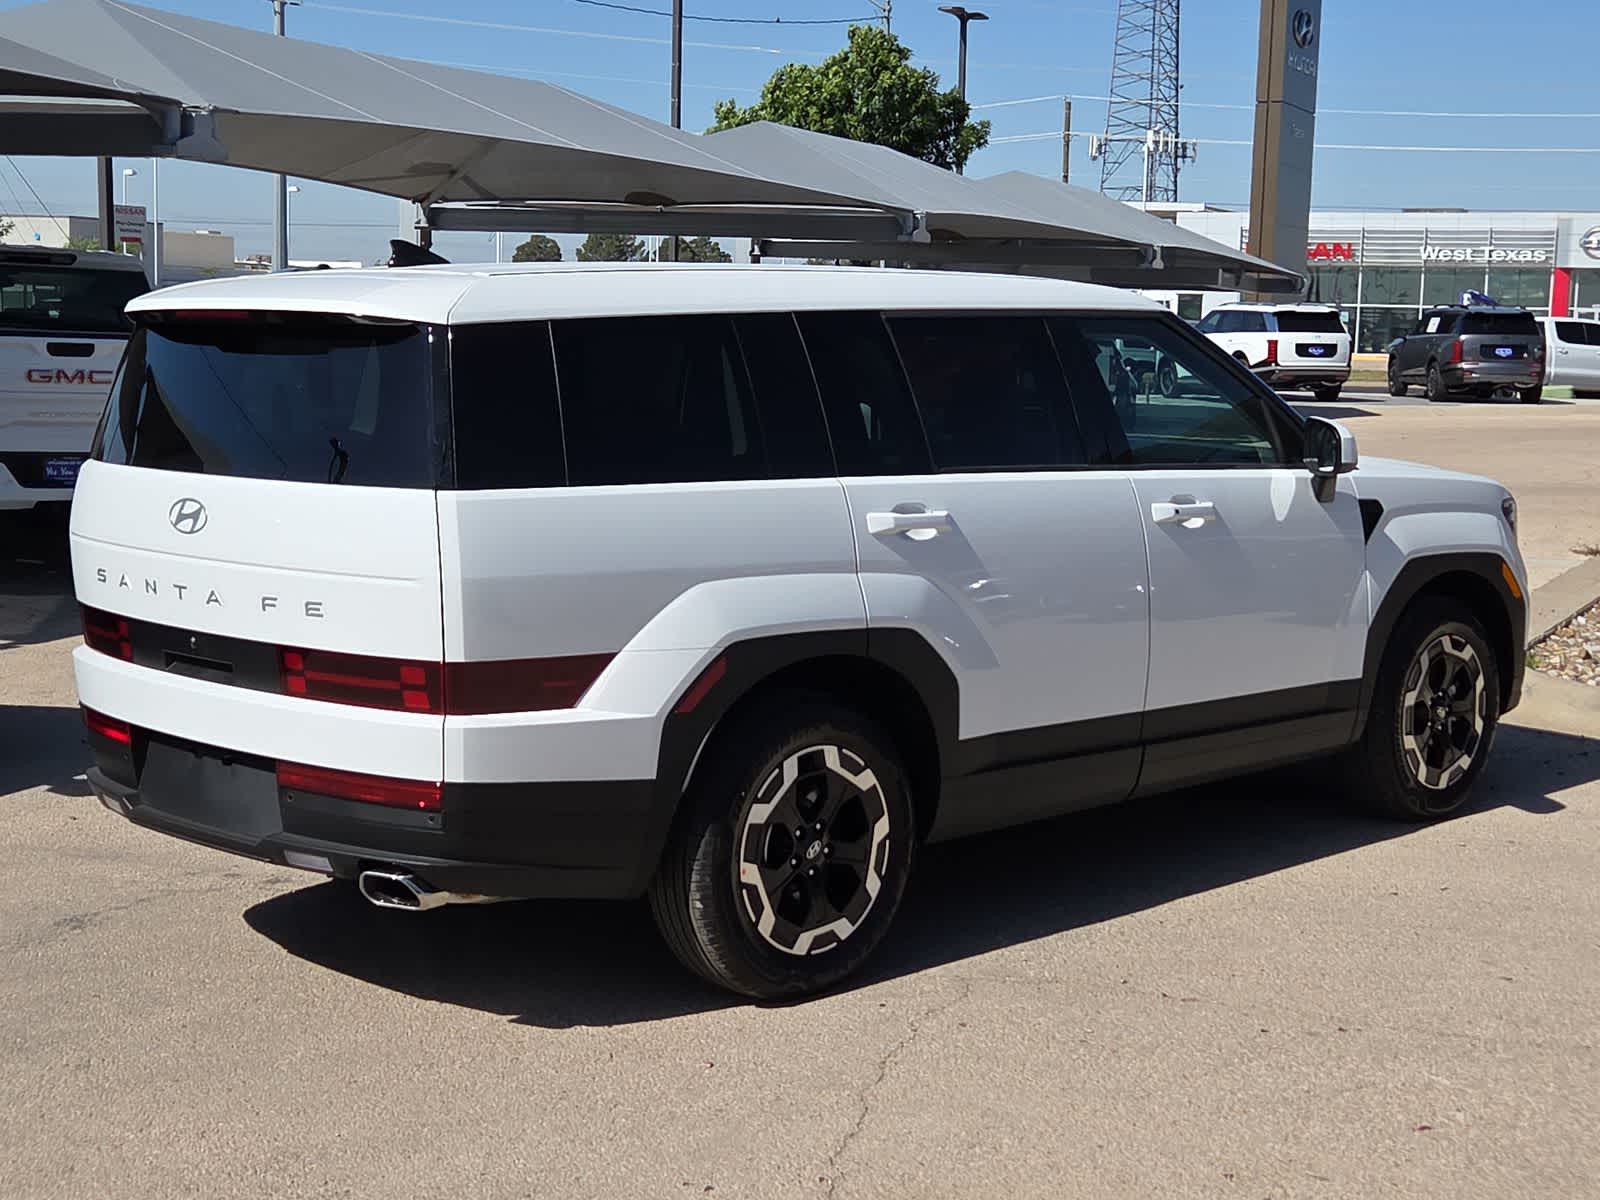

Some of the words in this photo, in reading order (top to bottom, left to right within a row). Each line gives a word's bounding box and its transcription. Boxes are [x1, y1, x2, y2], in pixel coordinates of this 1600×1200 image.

[115, 207, 145, 216] NISSAN
[1419, 245, 1473, 261] West
[1480, 245, 1546, 262] Texas
[26, 368, 113, 385] GMC
[97, 568, 223, 607] SANTA
[261, 596, 324, 618] FE
